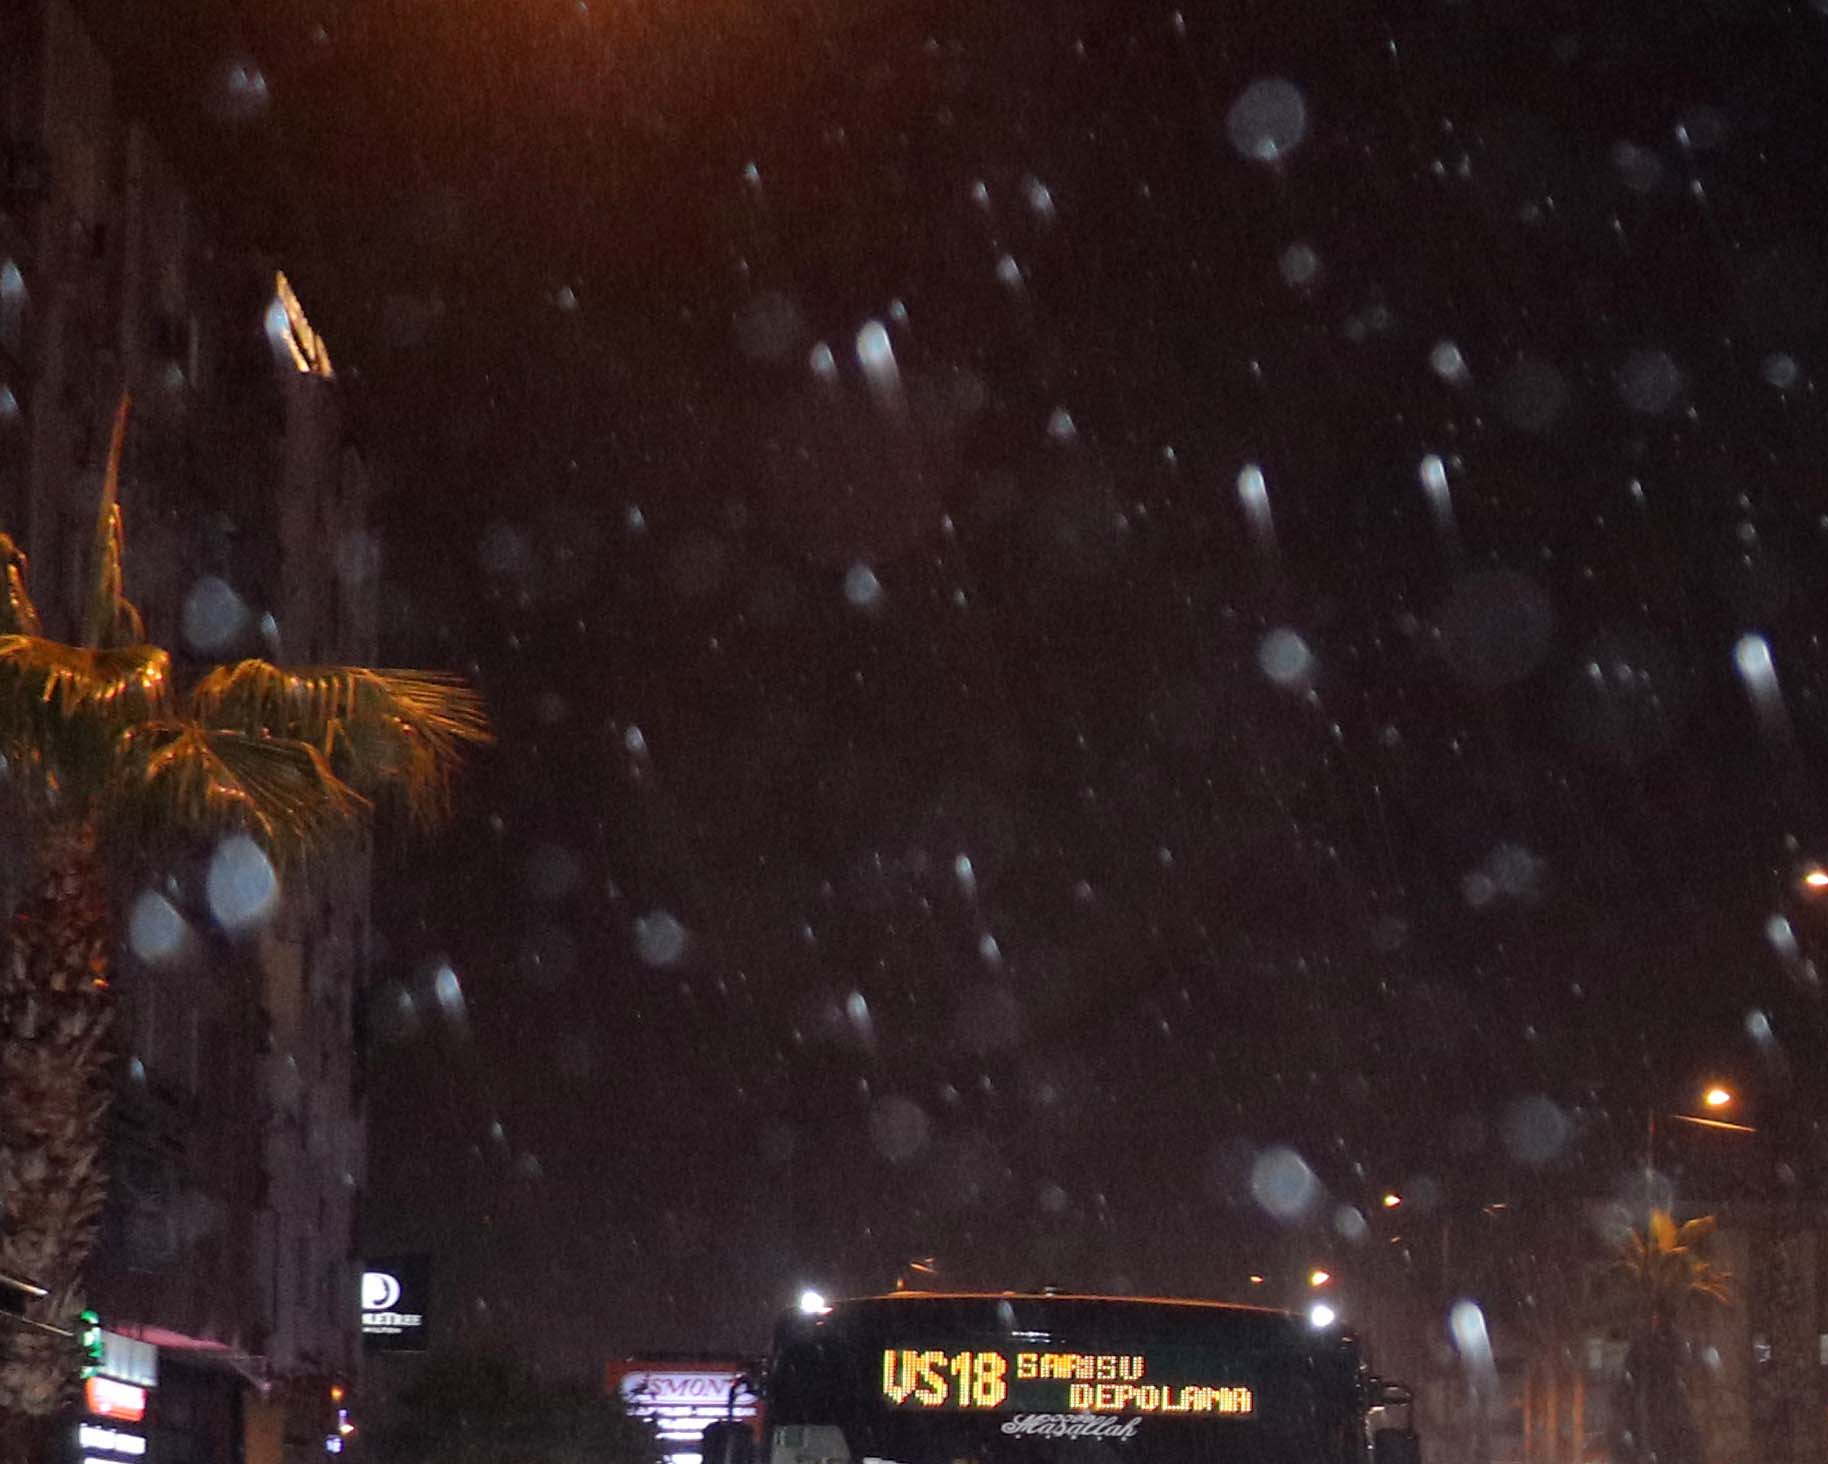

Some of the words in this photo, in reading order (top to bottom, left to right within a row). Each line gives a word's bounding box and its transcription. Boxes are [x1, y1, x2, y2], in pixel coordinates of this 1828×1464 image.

[883, 1349, 1007, 1408] VS18
[1016, 1352, 1145, 1381] SARISU
[1069, 1383, 1254, 1414] DEPOLAMA
